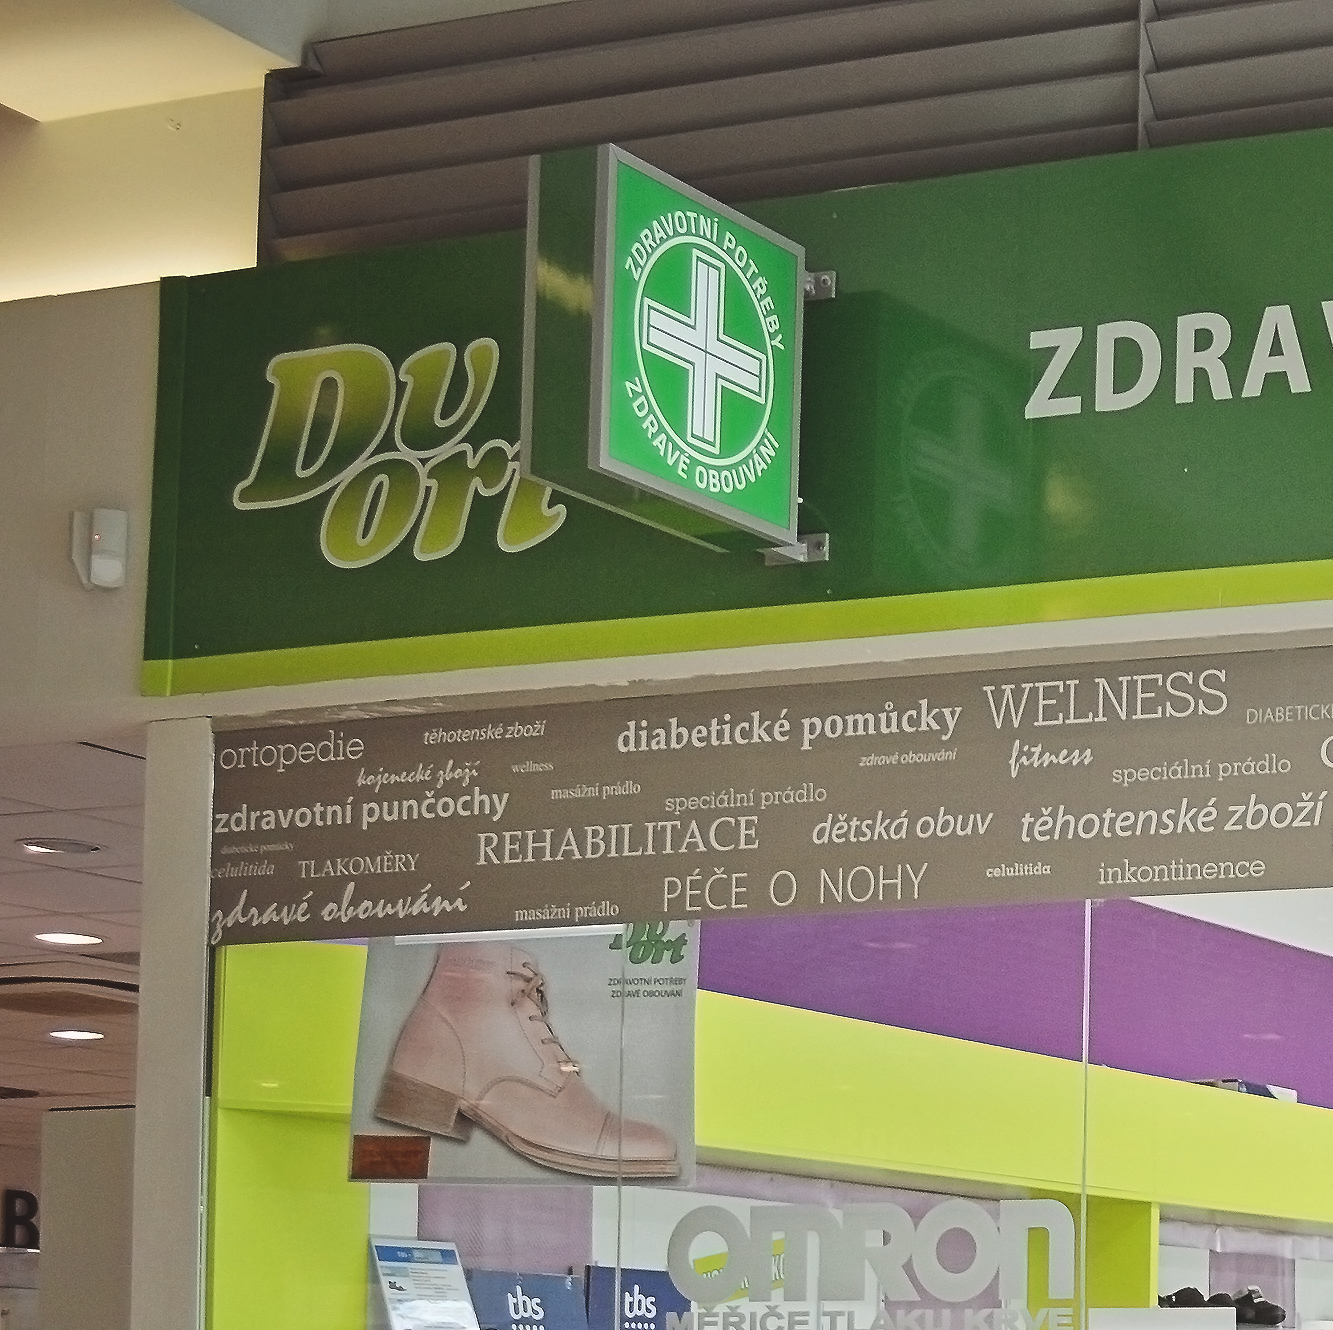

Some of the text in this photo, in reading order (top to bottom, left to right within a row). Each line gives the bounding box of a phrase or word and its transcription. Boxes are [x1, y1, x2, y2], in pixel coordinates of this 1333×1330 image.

[624, 210, 785, 352] ZDRAVOTNÍ POTŘEBY
[624, 377, 780, 493] ZDRAVÉ OBOUVÁNÍ
[983, 666, 1228, 730] WELNESS
[423, 720, 546, 746] těhotenské zboží
[617, 698, 963, 754] diabetické pomůcky
[219, 731, 364, 773] ortopedie
[511, 759, 554, 774] wellness
[858, 747, 957, 767] zdravé obouvání
[1009, 738, 1093, 780] fitness
[357, 759, 480, 789] kojenecké zboží
[1111, 754, 1291, 785] speciální prádlo
[550, 780, 641, 800] masážní prádlo
[665, 783, 827, 812] speciální prádlo
[214, 789, 510, 834] zdravotní punčochy
[812, 806, 992, 845] dětská obuv
[1020, 790, 1329, 843] těhotenské zboží
[476, 815, 759, 866] REHABILITACE
[211, 860, 275, 878] celulitida
[298, 851, 420, 879] TLAKOMĚRY
[986, 861, 1051, 879] celulitida
[1098, 855, 1265, 886] inkontinence
[663, 861, 929, 911] PÉČE O NOHY
[210, 880, 472, 945] zdravé obouvání
[514, 900, 620, 922] masážní prádlo
[507, 1285, 545, 1320] tbs
[624, 1290, 657, 1320] tbs
